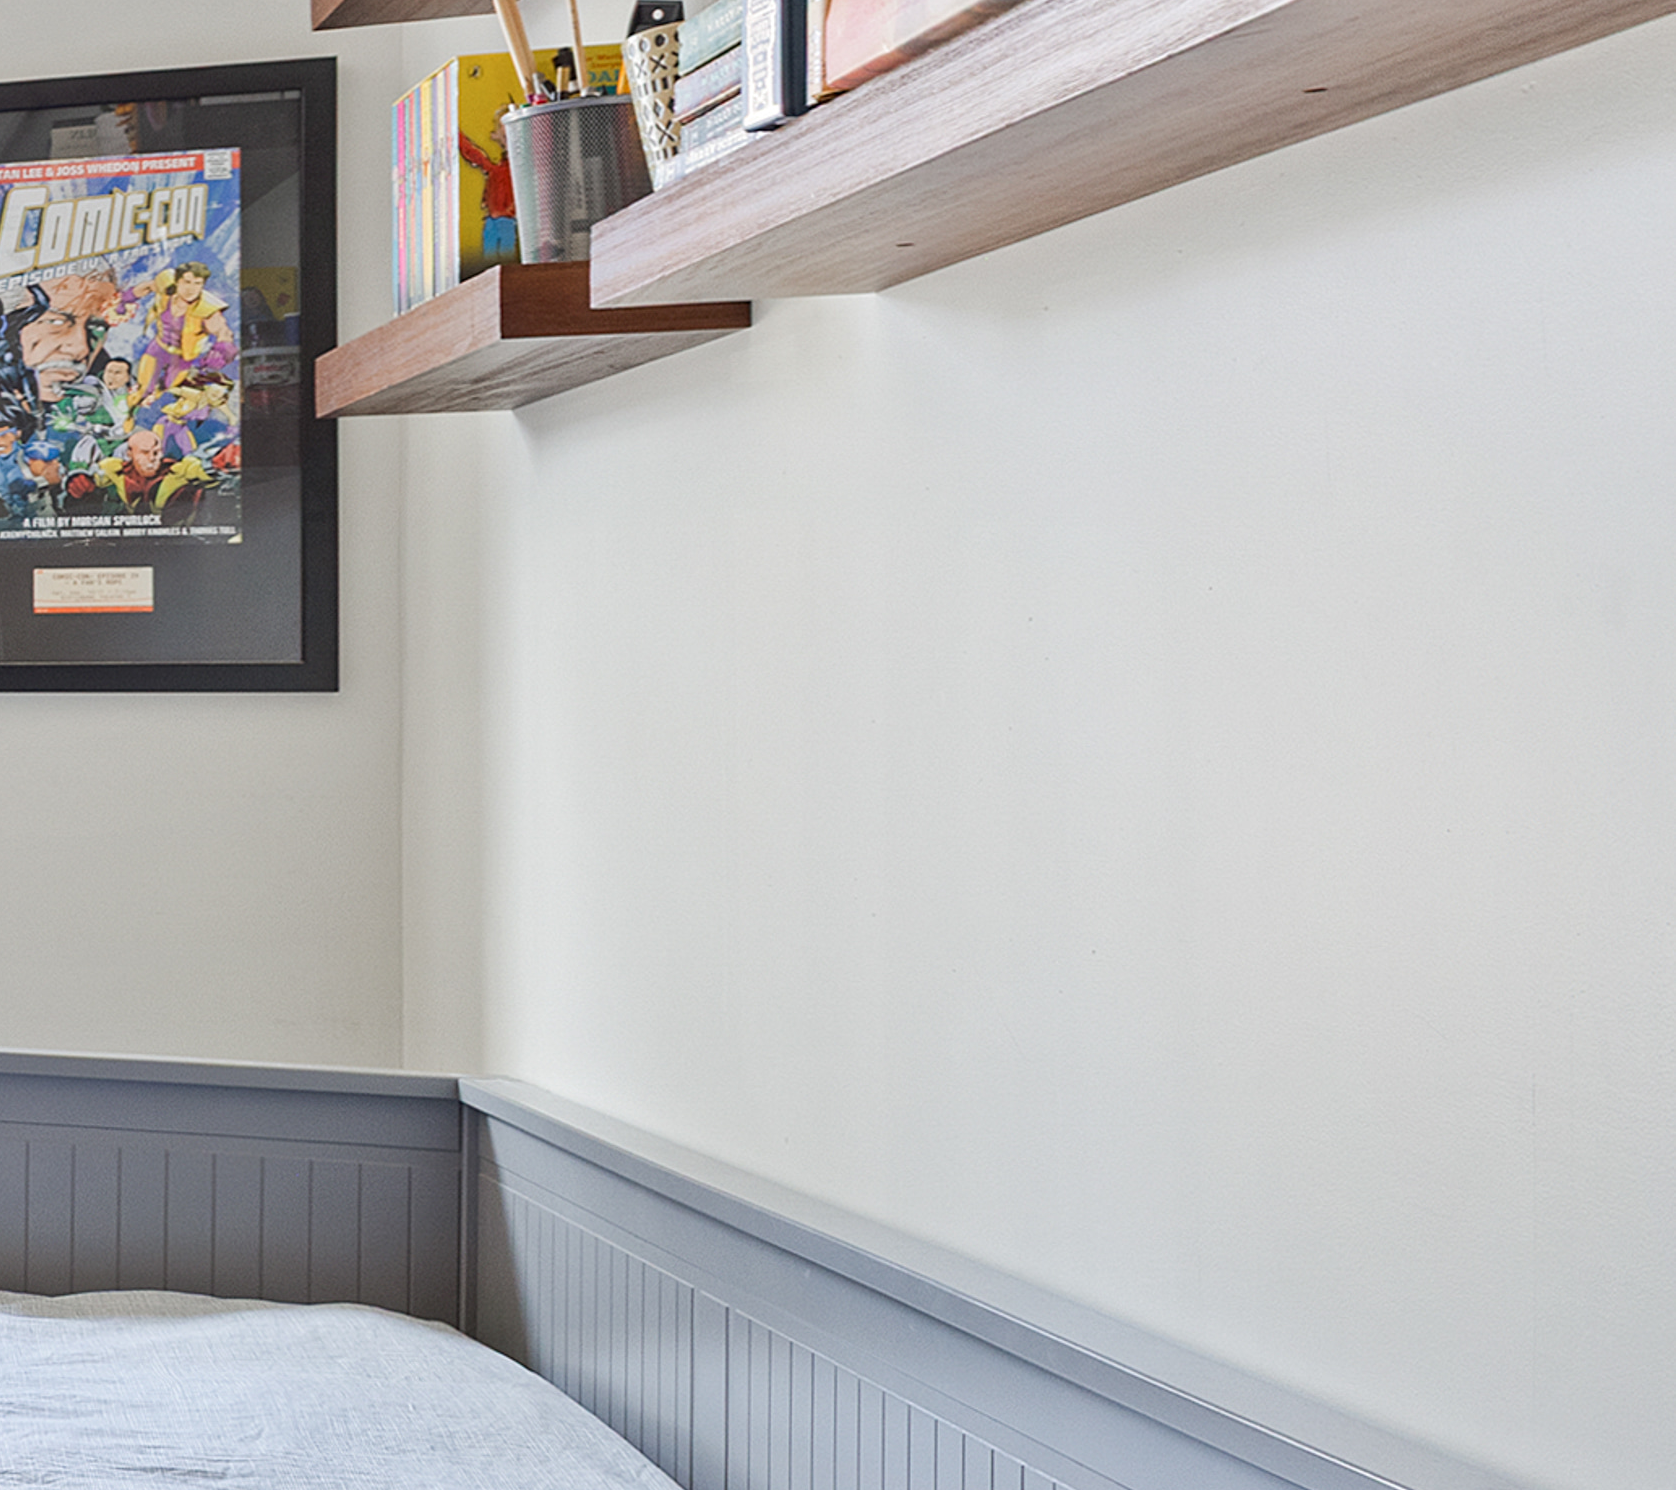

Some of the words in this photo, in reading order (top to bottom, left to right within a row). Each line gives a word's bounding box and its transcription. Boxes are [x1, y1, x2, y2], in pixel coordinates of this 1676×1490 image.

[22, 167, 43, 180] LEE
[46, 166, 54, 178] &
[56, 164, 85, 178] JOSS
[86, 160, 139, 175] WHEDON
[141, 157, 196, 171] PRESENT
[33, 517, 55, 528] FILM
[57, 516, 70, 528] BY
[114, 514, 162, 526] SPURLOCK
